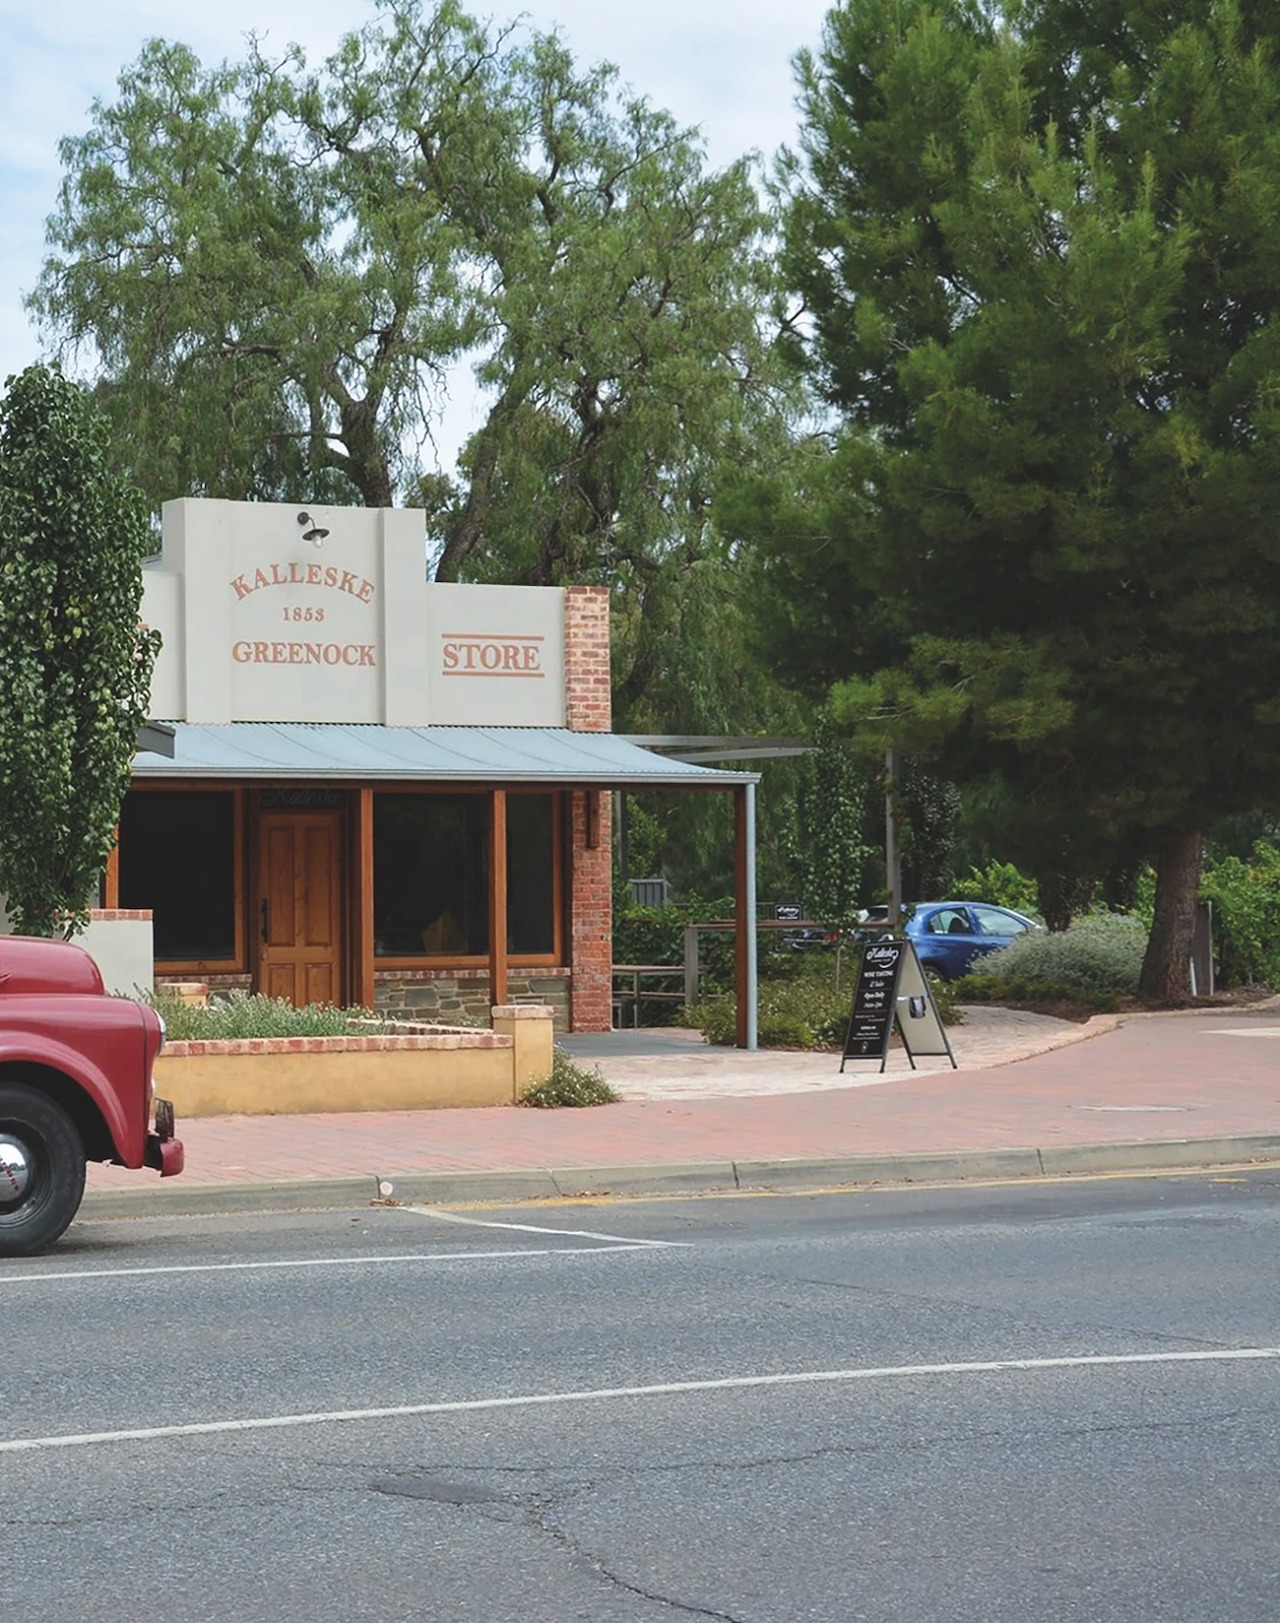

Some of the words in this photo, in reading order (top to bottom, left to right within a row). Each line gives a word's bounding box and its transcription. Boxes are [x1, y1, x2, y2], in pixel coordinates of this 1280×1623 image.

[230, 562, 375, 604] KALLESKE
[282, 607, 325, 622] 1853
[231, 641, 376, 666] GREENOCK
[443, 643, 541, 670] STORE
